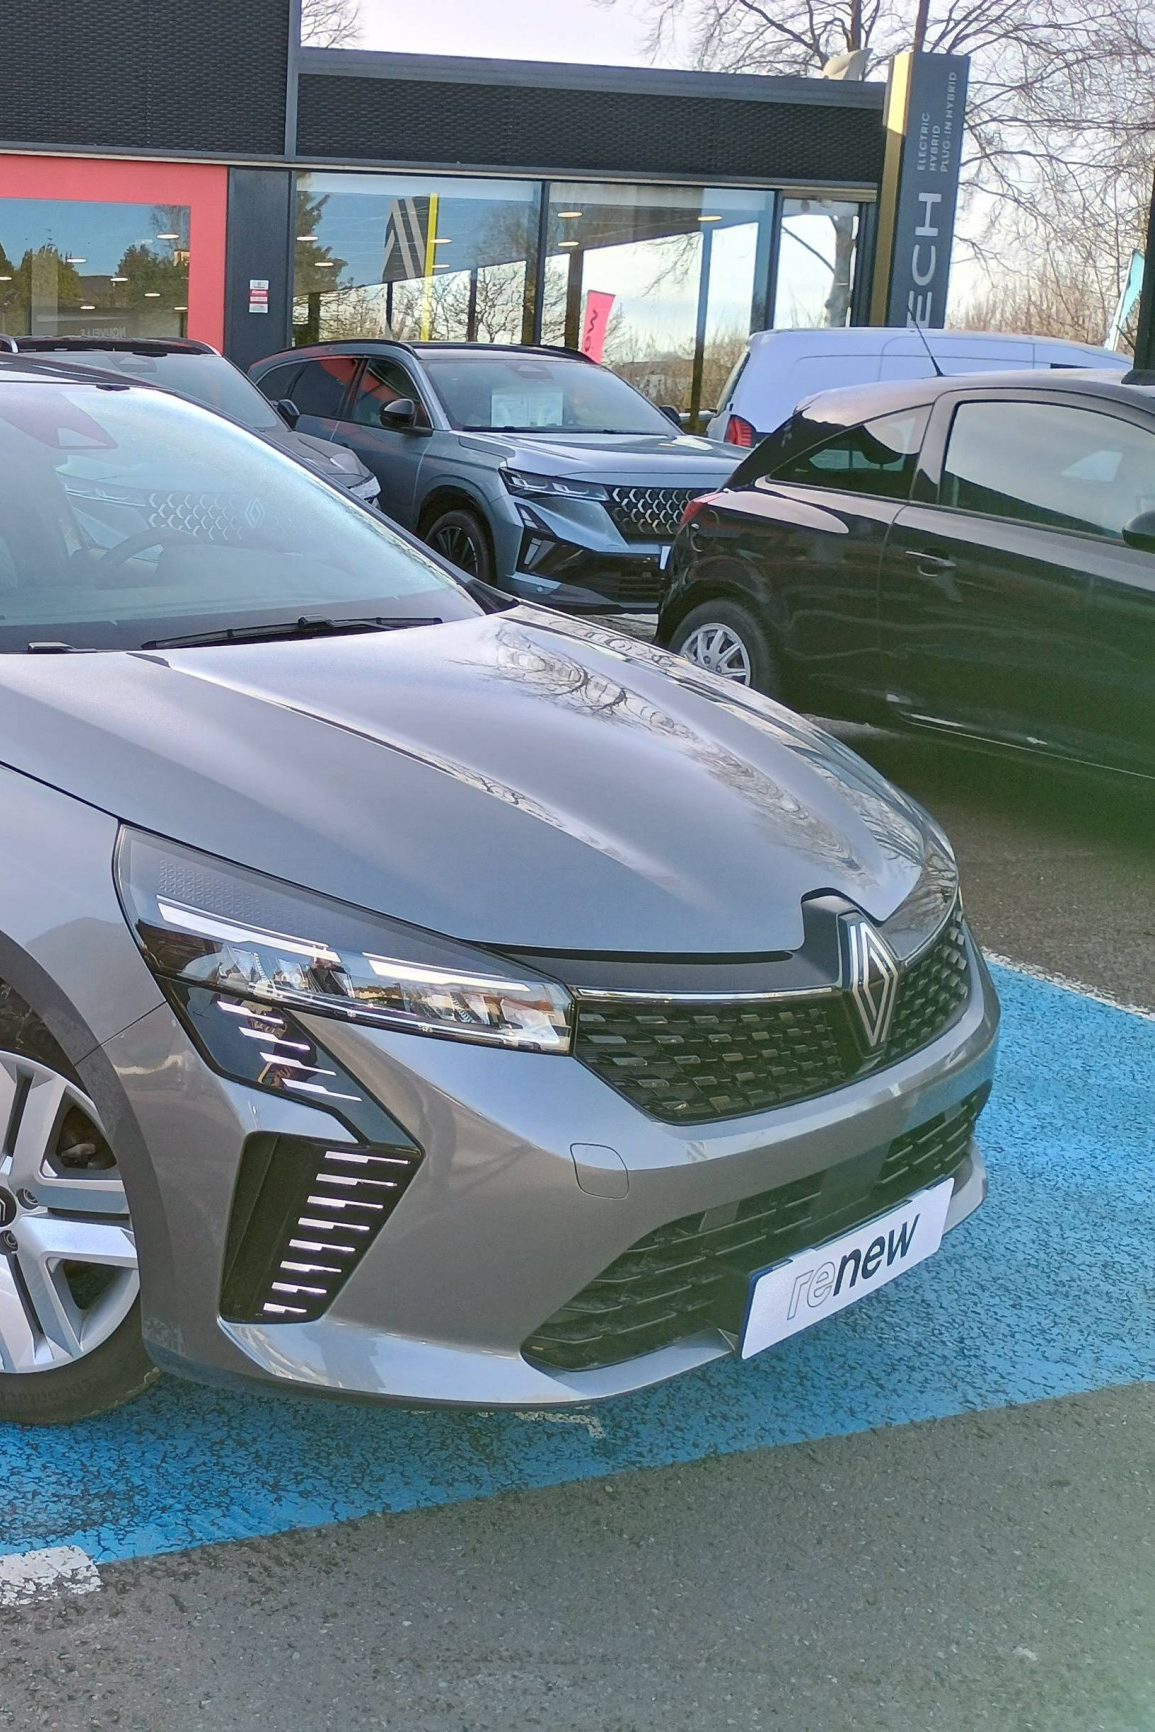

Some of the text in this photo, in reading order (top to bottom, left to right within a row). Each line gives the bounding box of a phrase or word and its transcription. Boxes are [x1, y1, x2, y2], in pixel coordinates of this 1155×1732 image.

[916, 112, 931, 171] ELECTRIC
[929, 125, 941, 172] HYBRID
[940, 71, 957, 173] PLUG-IN HYBRID
[786, 1213, 921, 1321] renew
